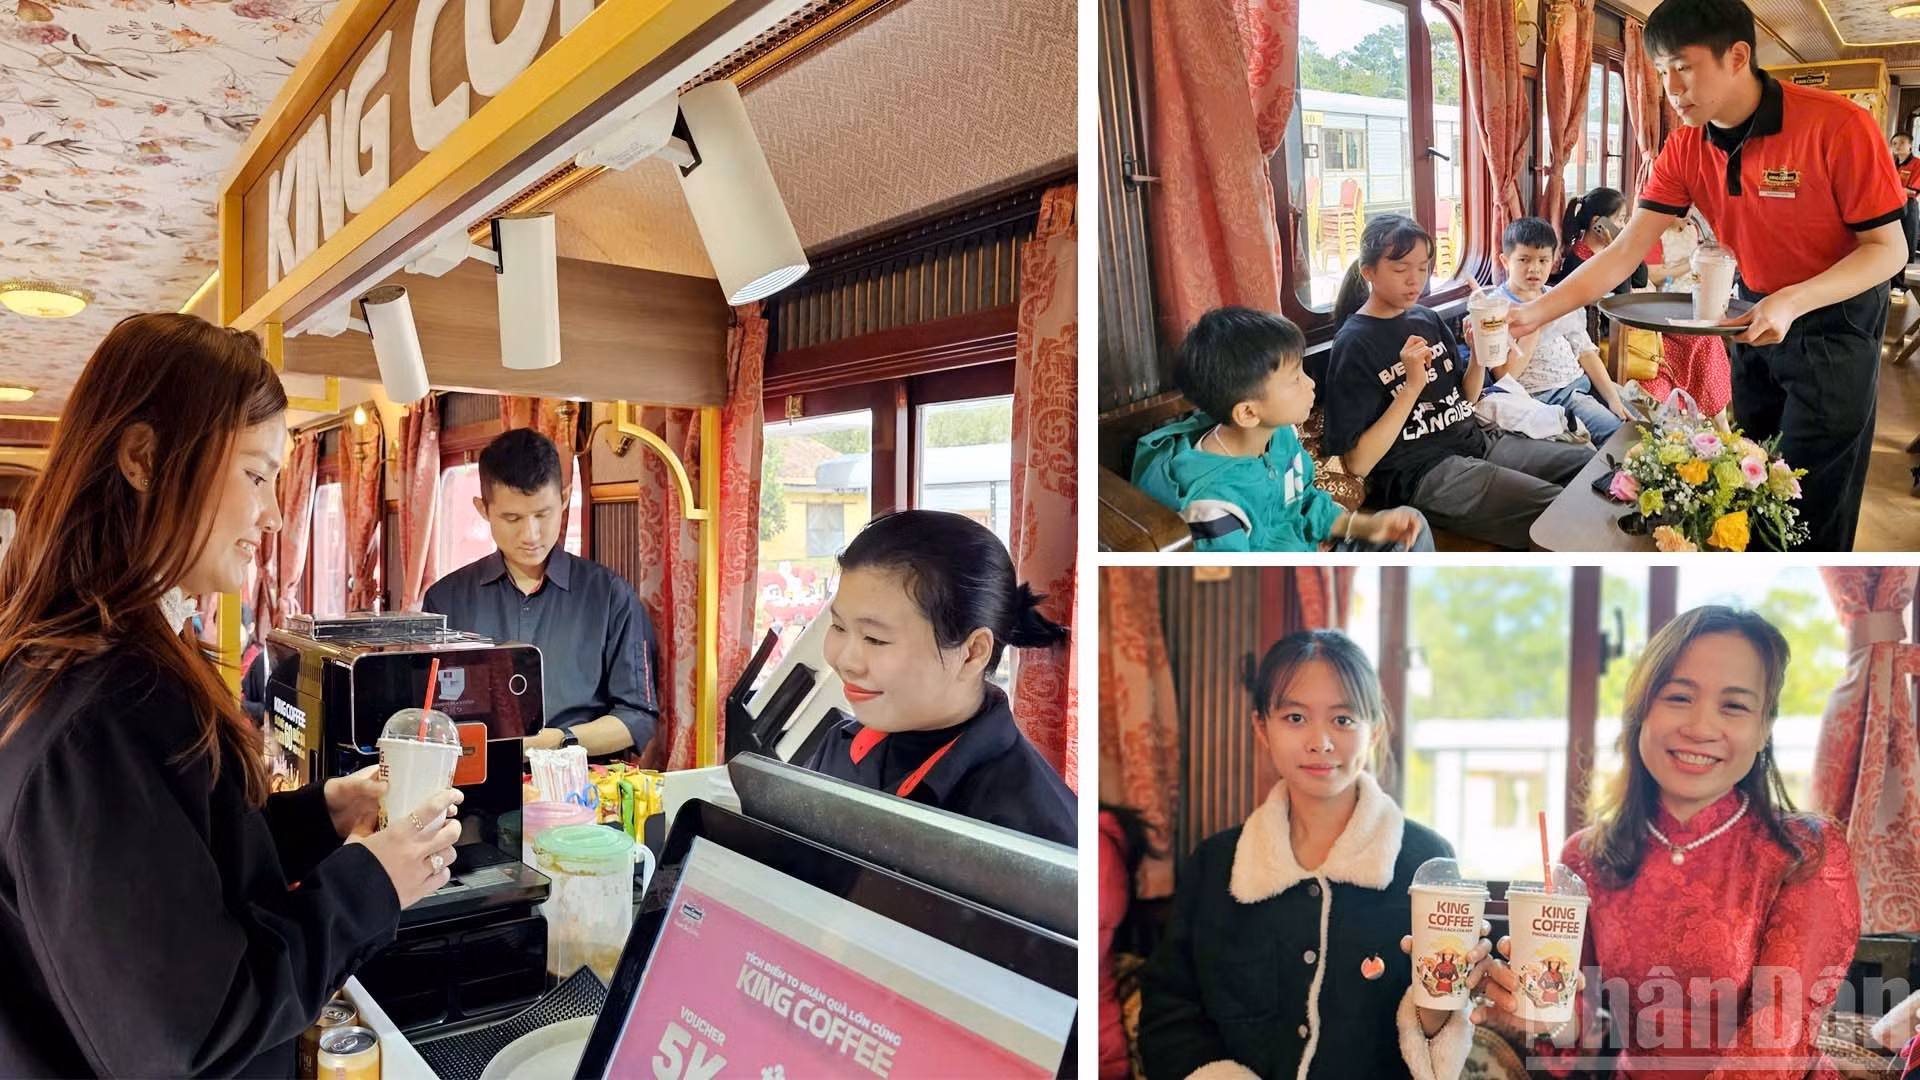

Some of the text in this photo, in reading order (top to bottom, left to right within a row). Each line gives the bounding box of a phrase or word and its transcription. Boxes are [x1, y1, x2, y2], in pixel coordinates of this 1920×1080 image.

[268, 30, 391, 290] KING
[1437, 901, 1470, 915] KING
[1542, 905, 1576, 920] KING
[1428, 913, 1474, 927] COFFEE
[1532, 918, 1580, 933] COFFEE
[787, 974, 799, 988] TO
[680, 1005, 727, 1047] VOUCHER
[735, 964, 897, 1080] KING COFFEE
